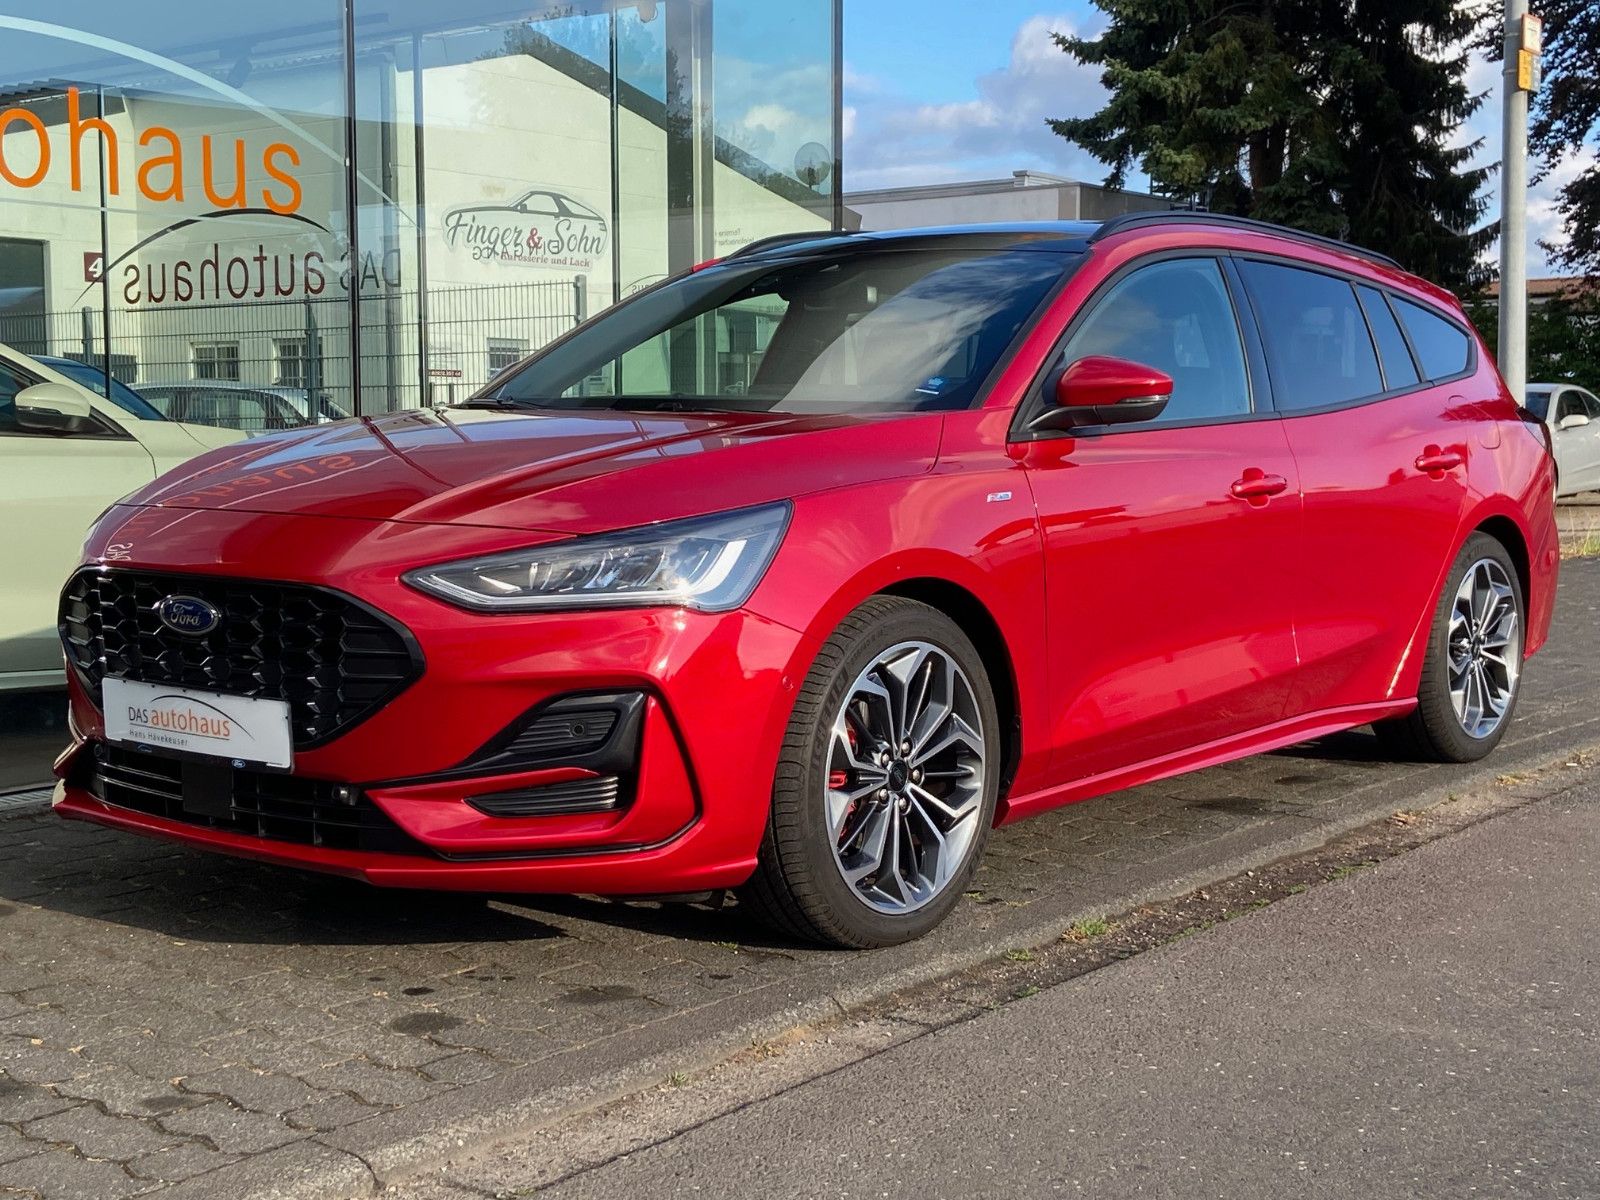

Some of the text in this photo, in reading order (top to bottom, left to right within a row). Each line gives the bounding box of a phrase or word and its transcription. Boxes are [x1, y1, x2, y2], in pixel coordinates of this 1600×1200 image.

[445, 212, 603, 258] Finger & Sohn
[550, 257, 567, 265] und
[569, 258, 590, 268] Lack
[170, 603, 201, 626] Ford
[128, 706, 231, 737] DAS autohaus
[129, 729, 145, 739] Hans
